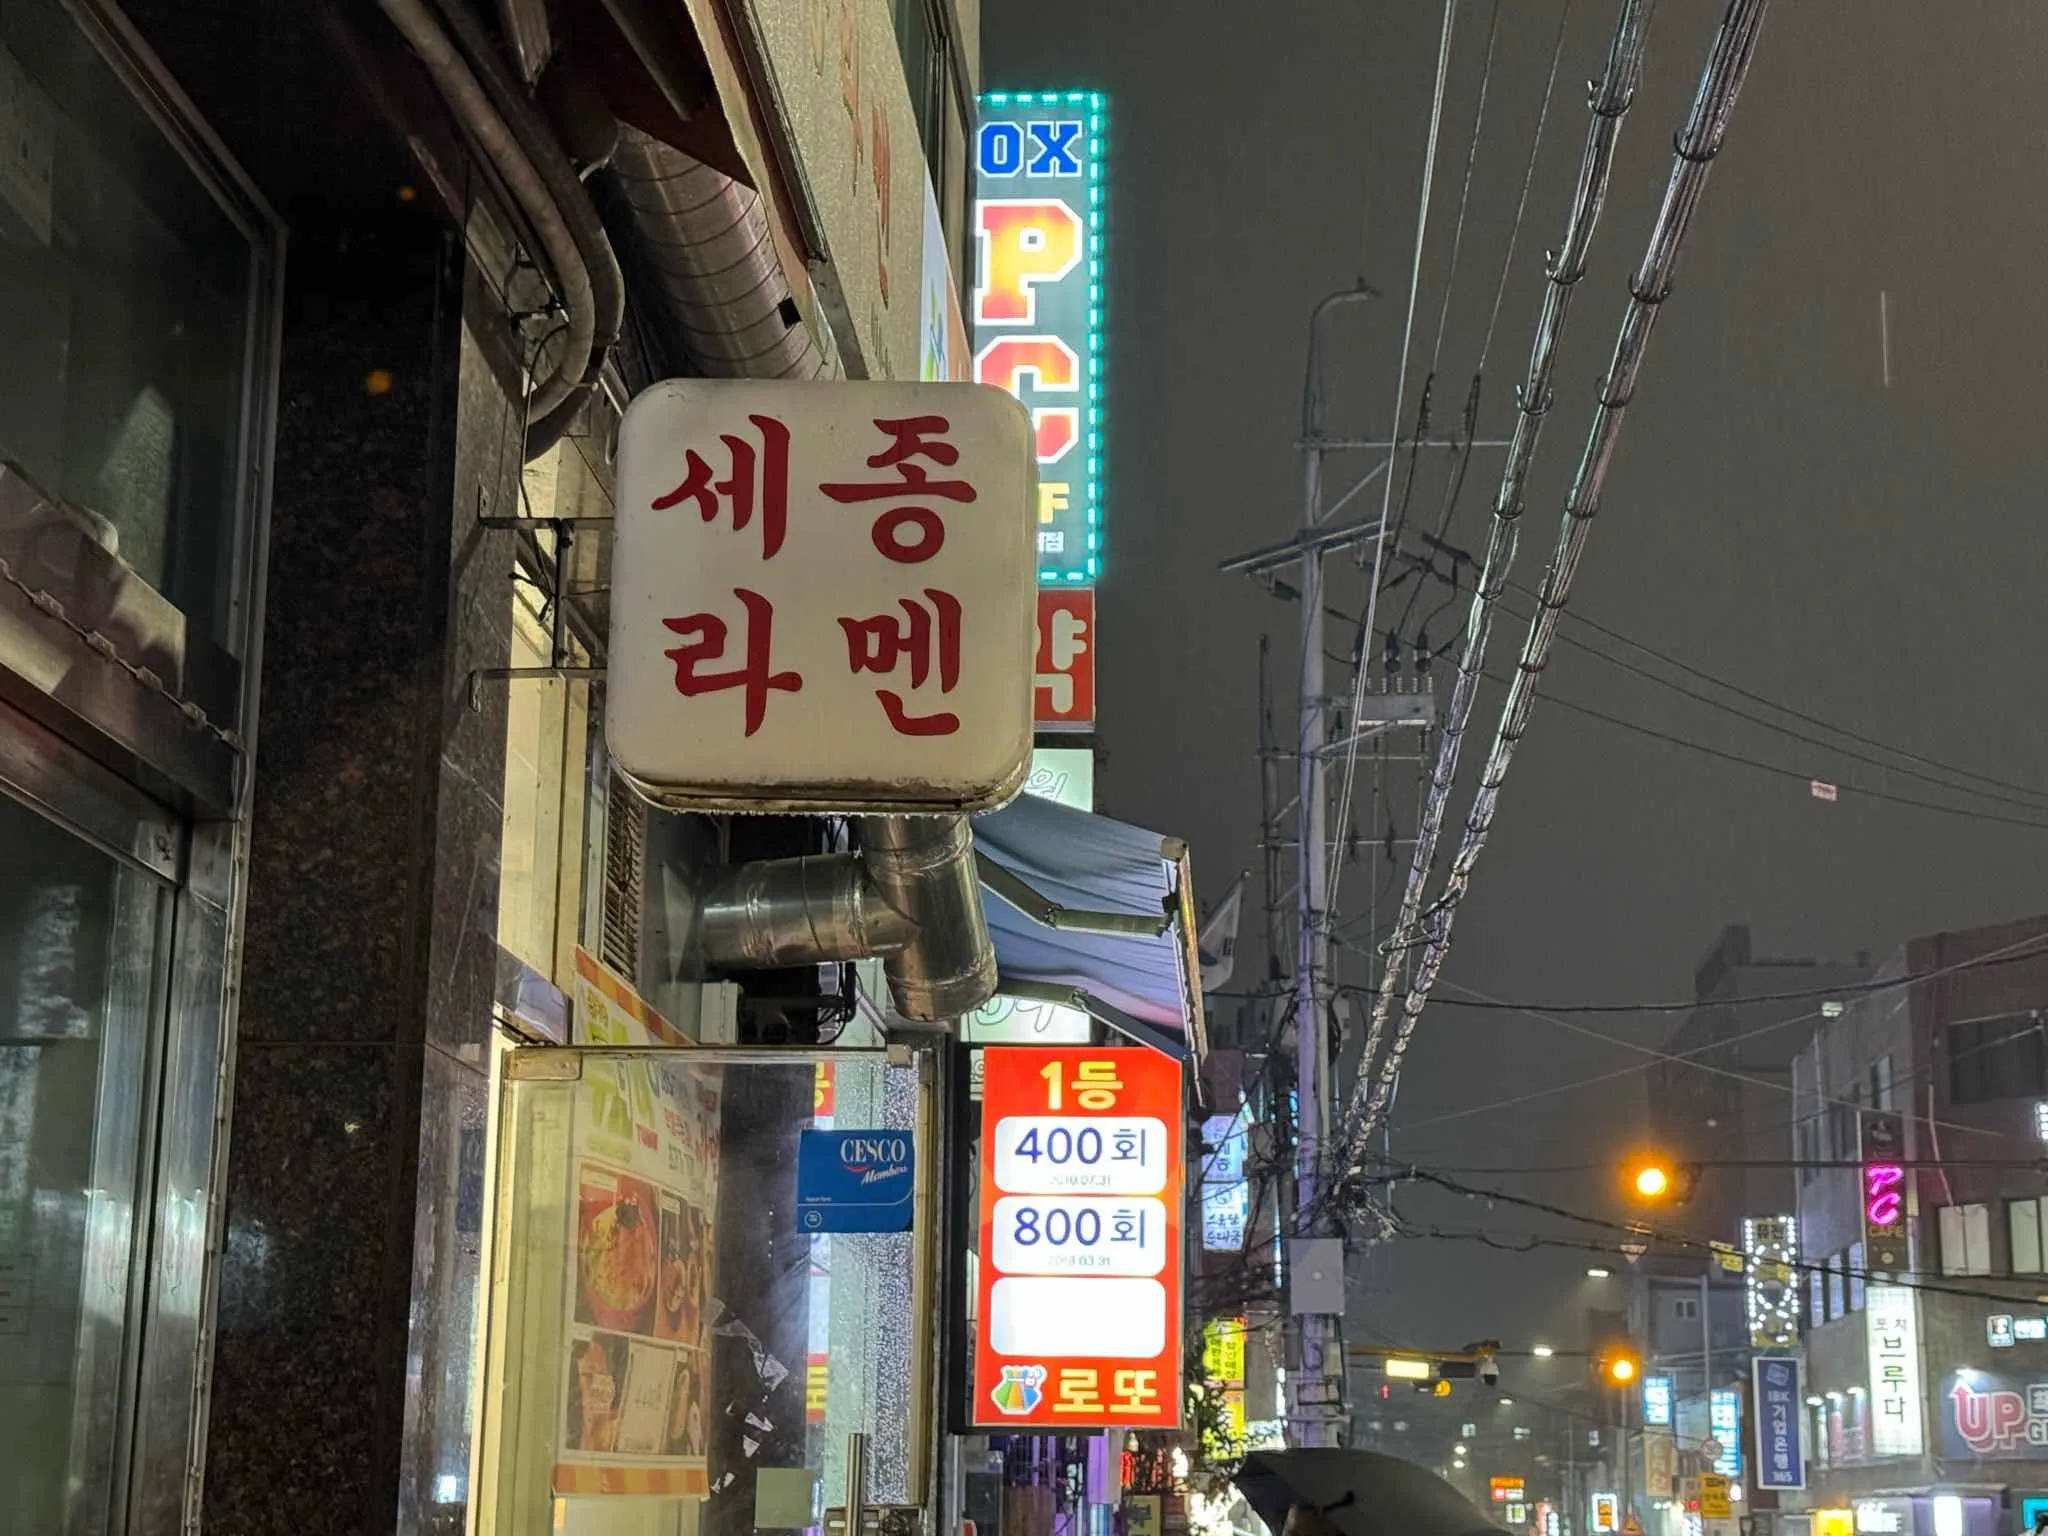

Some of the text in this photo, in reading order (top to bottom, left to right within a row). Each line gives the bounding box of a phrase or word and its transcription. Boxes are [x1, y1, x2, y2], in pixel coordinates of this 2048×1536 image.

[651, 414, 977, 563] 세종
[662, 588, 962, 737] 라멘
[1040, 1061, 1124, 1110] 1등
[840, 1138, 906, 1162] CESCO
[1014, 1127, 1146, 1167] 400회
[1867, 1166, 1903, 1224] PC
[1014, 1207, 1146, 1249] 800회
[1052, 1368, 1161, 1413] 로또
[1951, 1382, 2026, 1450] UP
